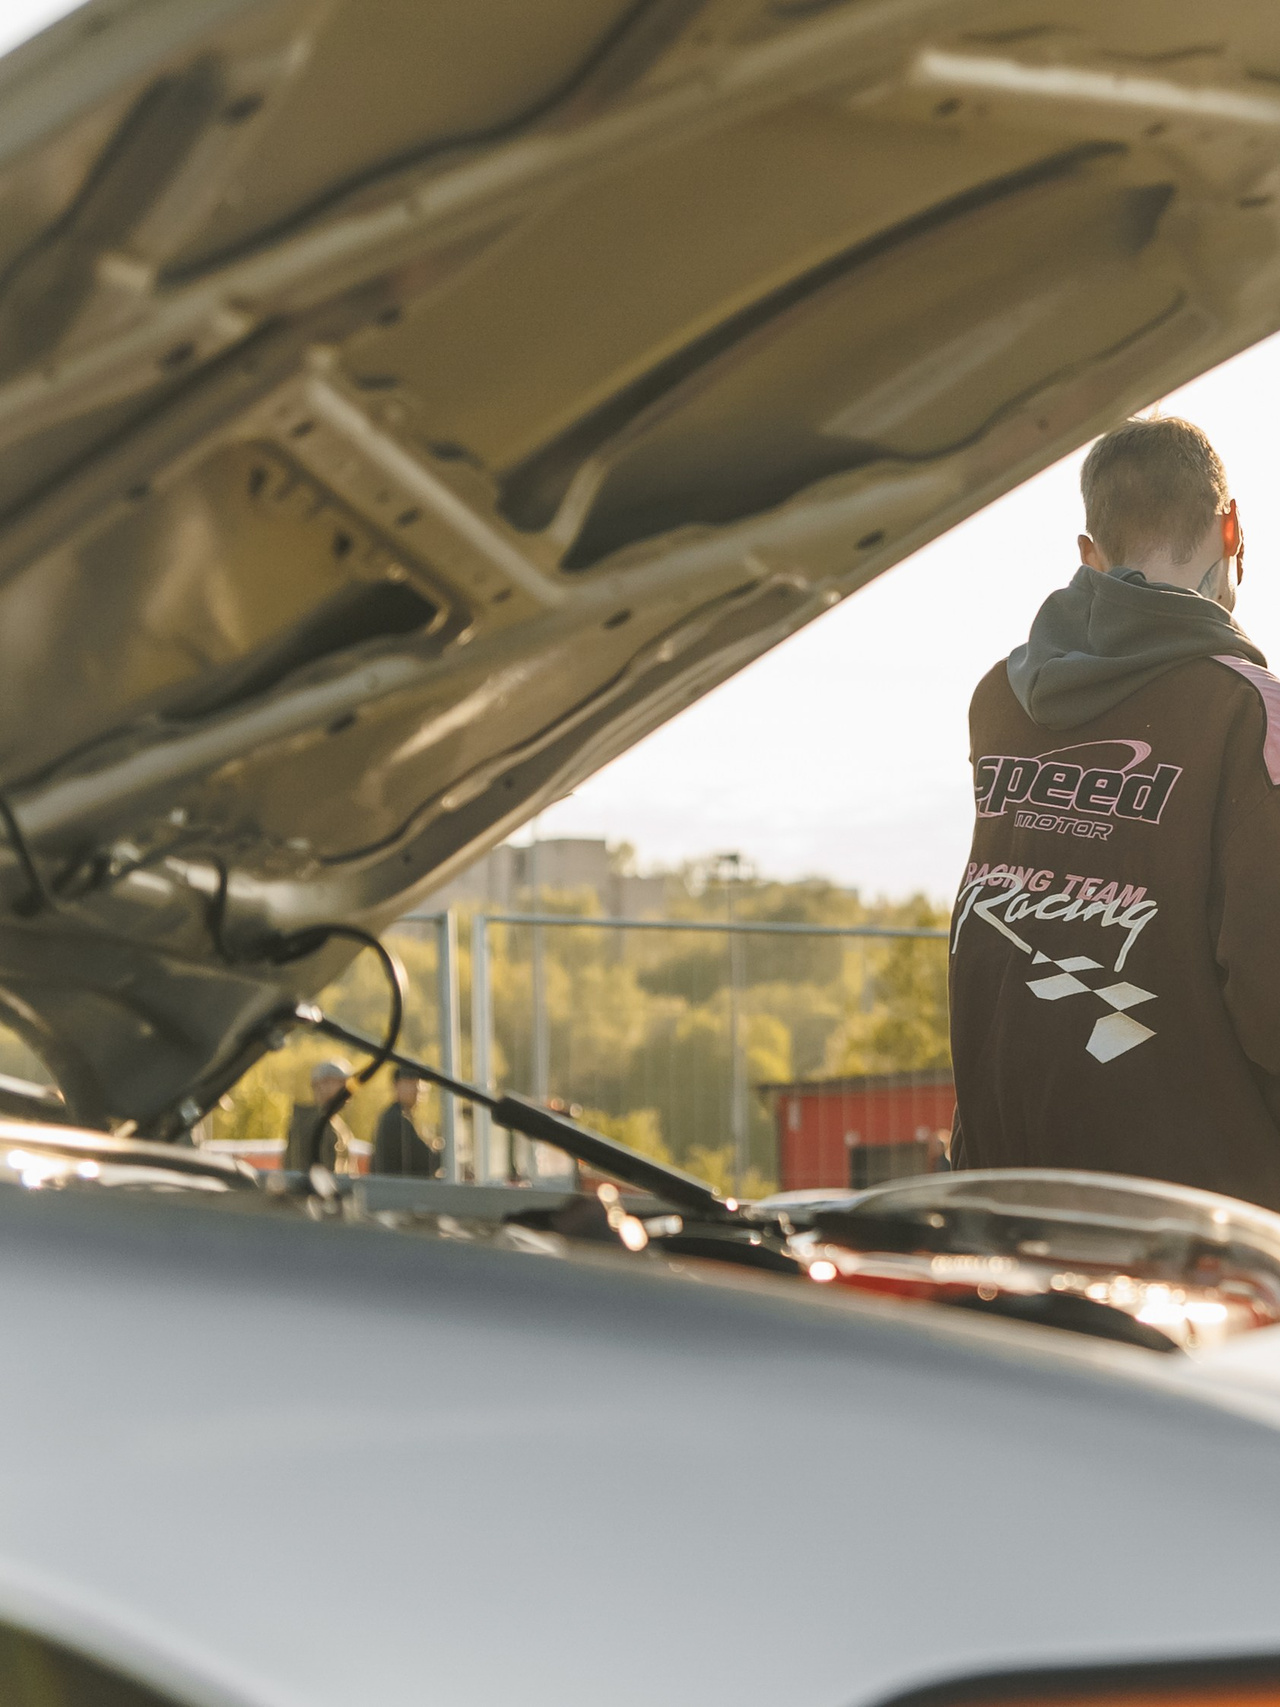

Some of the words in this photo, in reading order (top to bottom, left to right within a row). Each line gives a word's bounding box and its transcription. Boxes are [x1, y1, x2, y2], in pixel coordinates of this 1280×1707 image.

[964, 862, 1055, 892] RACING
[1061, 873, 1147, 908] TEAM
[951, 872, 1158, 973] Racing
